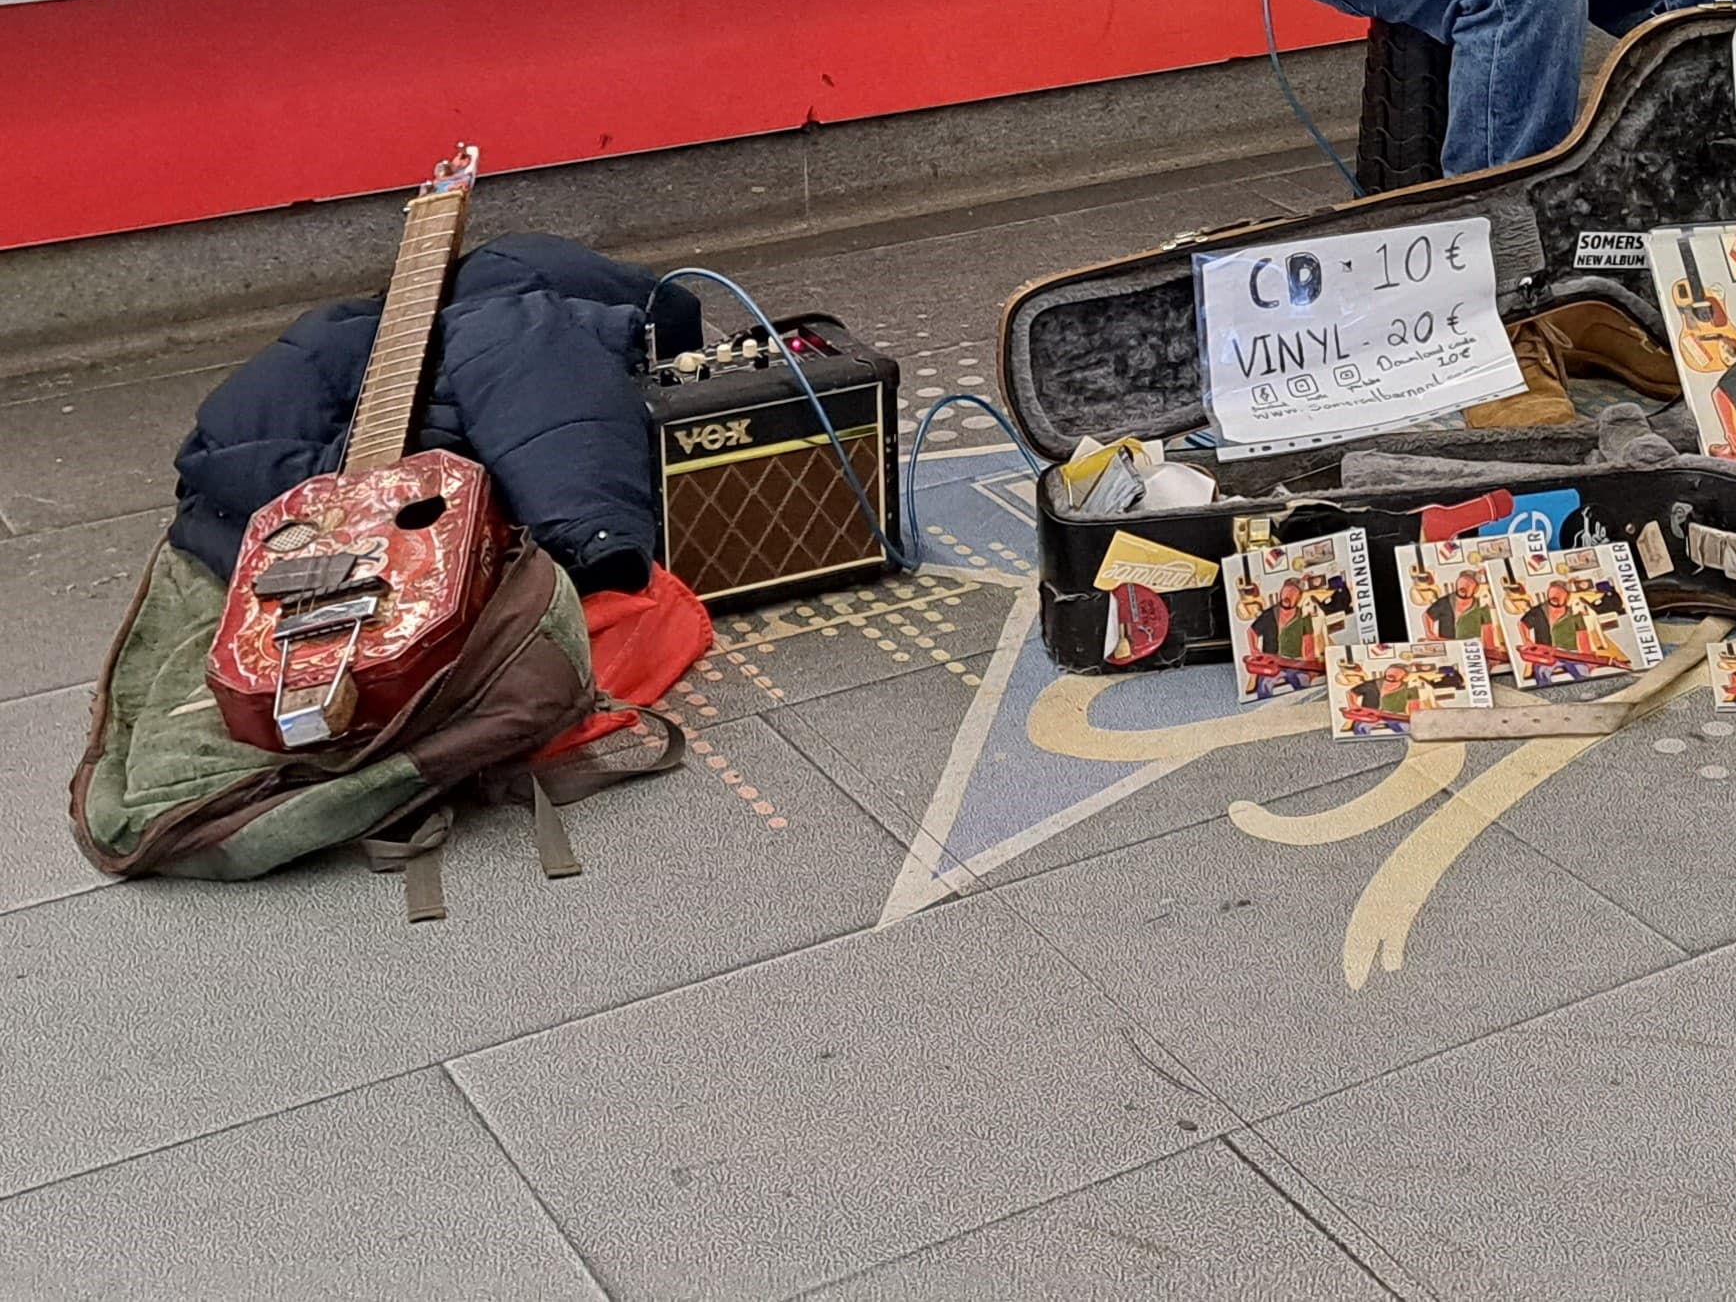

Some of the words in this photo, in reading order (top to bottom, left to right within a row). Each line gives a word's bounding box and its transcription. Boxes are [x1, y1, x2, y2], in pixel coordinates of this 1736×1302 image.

[1249, 251, 1323, 310] CD
[1576, 254, 1604, 266] NEW
[1604, 254, 1646, 266] ALBUM
[1231, 322, 1351, 379] VINYL
[673, 418, 753, 455] VOX
[1349, 530, 1375, 623] STRANGER
[1612, 543, 1649, 624] STRANGER
[1463, 640, 1489, 698] STRANGER
